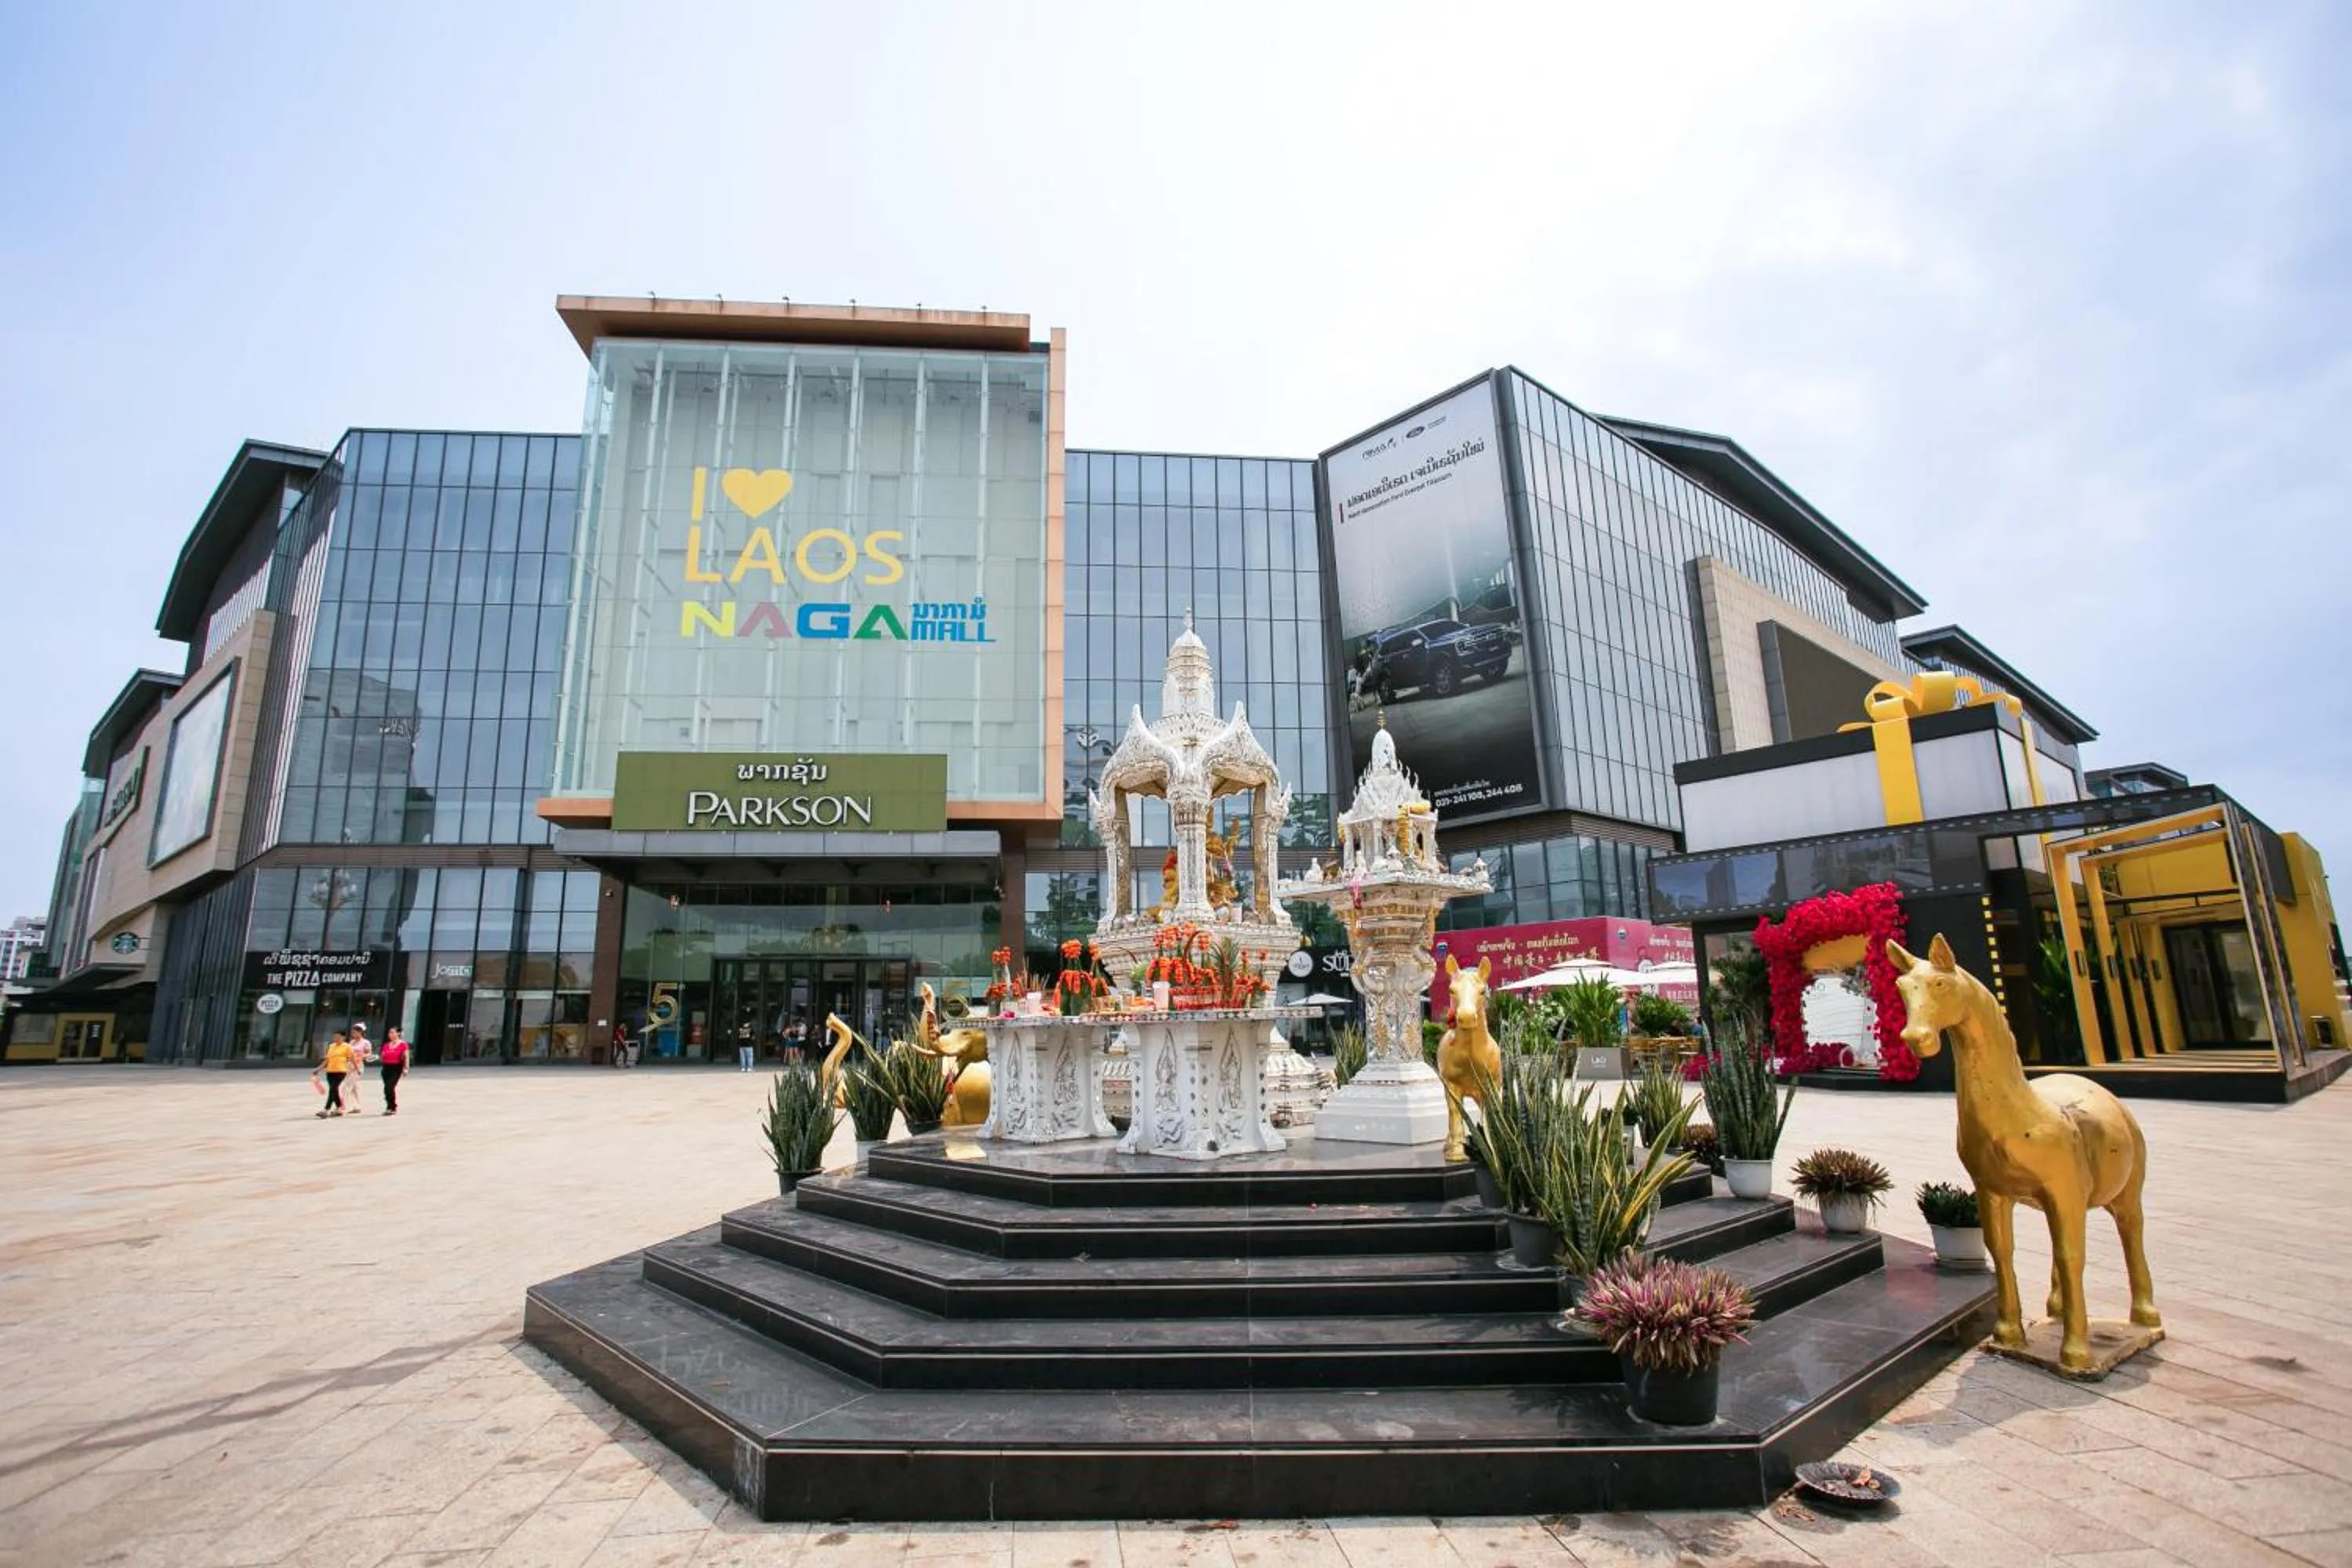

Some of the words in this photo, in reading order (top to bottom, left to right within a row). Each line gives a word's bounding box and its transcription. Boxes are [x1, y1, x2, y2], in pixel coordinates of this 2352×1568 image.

[691, 466, 706, 521] I
[685, 526, 904, 586] LAOS
[681, 601, 909, 641] NAGA
[911, 621, 996, 642] MALL
[687, 791, 873, 826] PARKSON
[267, 972, 283, 985] THE
[284, 970, 321, 988] PIZZA
[322, 971, 363, 984] COMPANY
